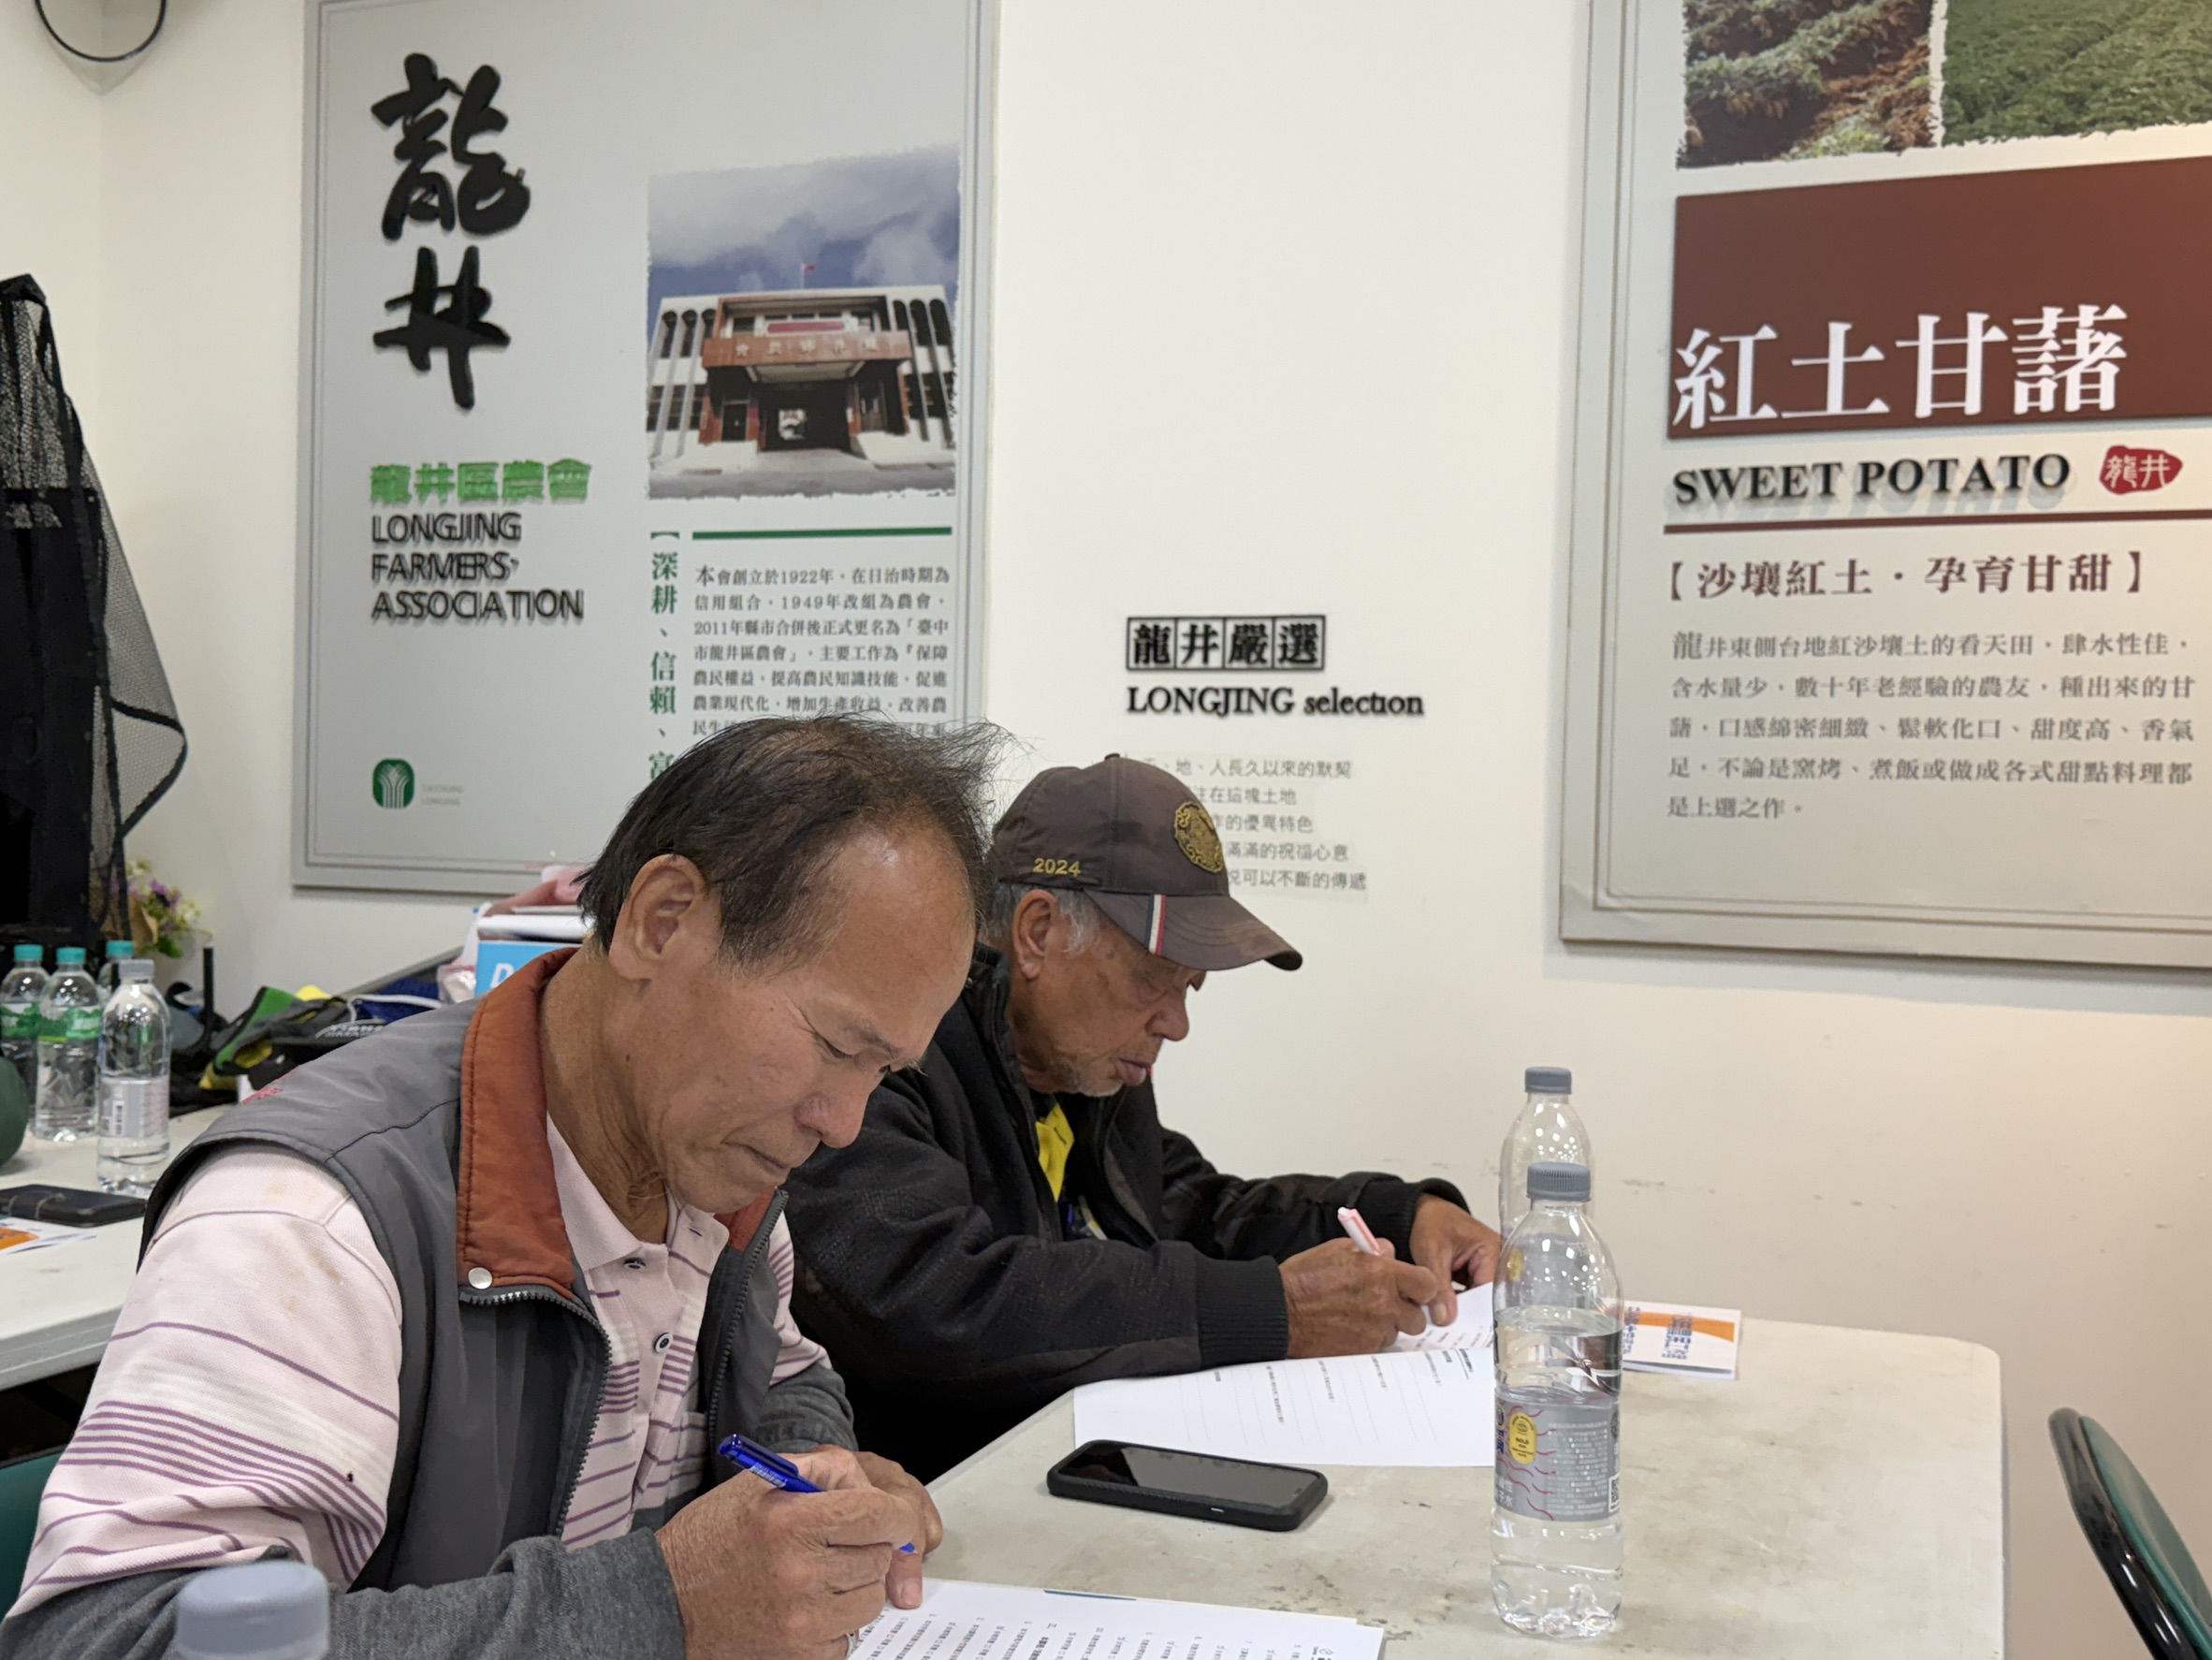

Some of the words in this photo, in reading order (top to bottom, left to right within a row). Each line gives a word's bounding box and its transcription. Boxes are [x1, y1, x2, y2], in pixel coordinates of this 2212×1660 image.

[371, 52, 531, 412] 龍井
[1674, 460, 1842, 507] SWEET
[1856, 453, 2070, 497] POTATO
[371, 512, 522, 543] LONGJING
[371, 589, 584, 619] ASSOCIATION
[1133, 623, 1319, 665] 龍井嚴選
[1127, 687, 1295, 718] LONGJING
[1303, 687, 1425, 717] selection
[1033, 857, 1082, 877] 2024
